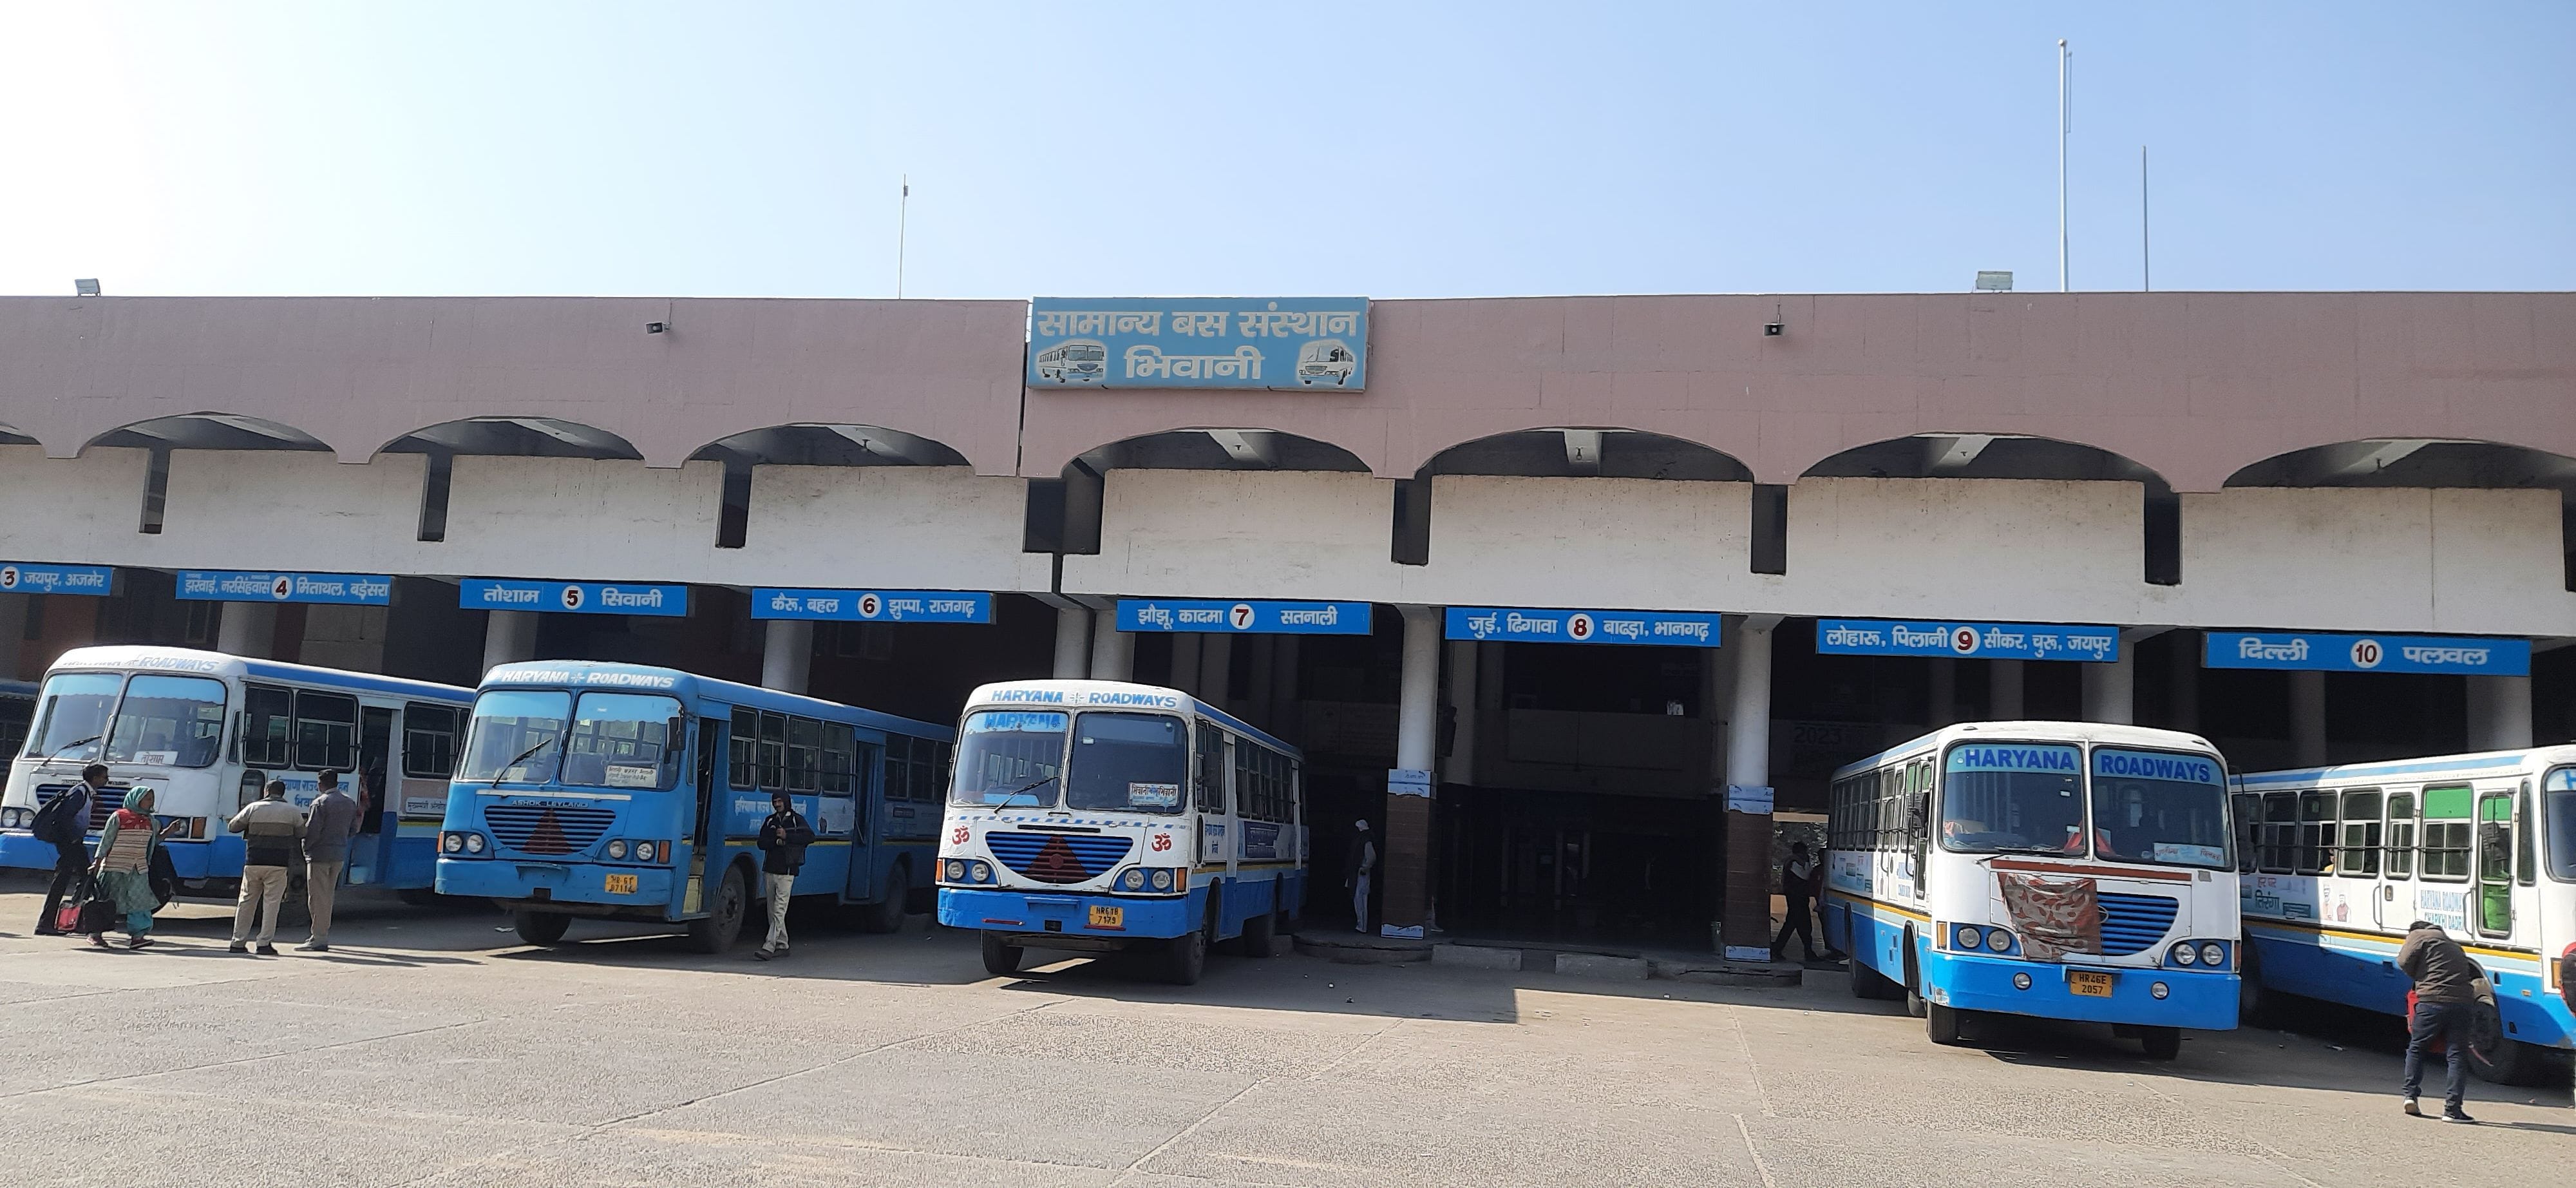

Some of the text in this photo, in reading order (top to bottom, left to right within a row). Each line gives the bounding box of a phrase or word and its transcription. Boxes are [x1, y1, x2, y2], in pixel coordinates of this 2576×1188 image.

[1038, 302, 1360, 337] सामान्य बस संस्थान
[1123, 345, 1265, 379] भिवानी
[5, 570, 104, 591] 3 जयपुर, अजमेर
[276, 580, 287, 595] 4
[296, 577, 346, 597] मिताथल,
[484, 584, 663, 608] तोशाम 5 सिवानी
[807, 599, 840, 613] बहल
[863, 598, 875, 614] 6
[888, 599, 925, 620] झुप्पा,
[929, 600, 976, 618] राजगढ़
[1179, 609, 1224, 623] कादमा
[1235, 609, 1249, 626] 7
[1280, 605, 1338, 626] सतनाली
[1468, 612, 1501, 639] जुई,
[1507, 612, 1558, 633] ढिगावा
[1574, 618, 1587, 637] 8
[1654, 622, 1710, 642] भानगढ़
[1826, 625, 2112, 660] लोहारू, पिलानी 9 सीकर, चुरू, जयपुर
[2239, 637, 2490, 665] दिल्ली 10 पलवल
[138, 656, 220, 671] ROADWAYS
[501, 670, 675, 688] HARYANA ROADWAYS
[991, 690, 1177, 707] HARYANA ROADWAYS
[1965, 749, 2211, 783] HARYANA ROADWAYS
[1097, 915, 1116, 924] 7179
[2079, 973, 2107, 984] HR46E
[2082, 984, 2103, 995] 2057
